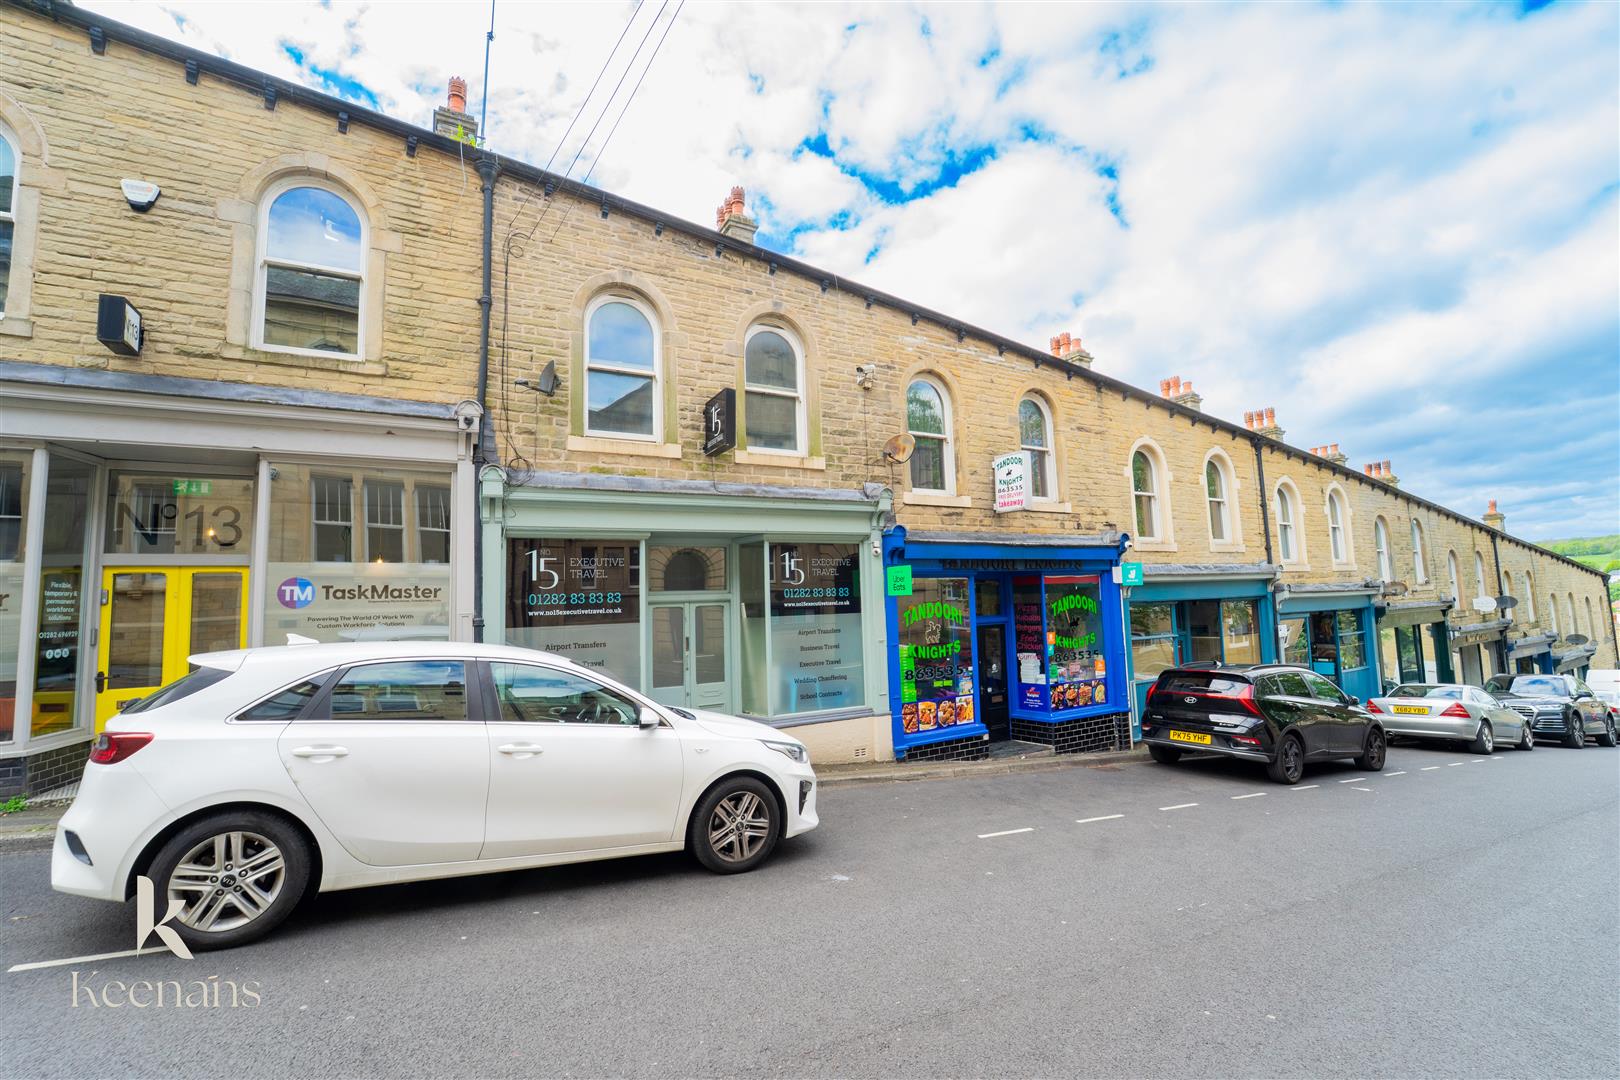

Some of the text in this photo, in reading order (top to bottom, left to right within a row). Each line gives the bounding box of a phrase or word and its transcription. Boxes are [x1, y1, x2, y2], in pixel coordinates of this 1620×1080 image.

[996, 456, 1024, 471] TANDOORI
[998, 475, 1023, 486] KNIGHTS
[570, 558, 625, 567] EXECUTIVE
[780, 551, 805, 585] 15
[812, 558, 851, 567] EXECUTIVE
[525, 549, 559, 590] 15
[570, 569, 608, 579] TRAVEL
[812, 568, 839, 576] TRAVEL
[281, 585, 313, 601] TM
[321, 584, 442, 601] TaskMaster
[784, 587, 849, 598] 01282 83 83 83
[529, 592, 622, 606] 01282 83 83 83
[1051, 594, 1097, 617] TANDOORI
[528, 608, 622, 617] www.no15executivetravel.co.uk
[903, 602, 963, 628] TANDOORI
[545, 641, 607, 651] Airport Transfers
[1055, 632, 1096, 649] KNIGHTS
[908, 640, 961, 659] KNIGHTS
[1054, 649, 1100, 662] 863535
[581, 659, 605, 667] Travel
[825, 658, 841, 666] Travel
[904, 664, 964, 681] 863535
[800, 690, 842, 700] School Contracts
[1172, 732, 1208, 742] PK75 YHF
